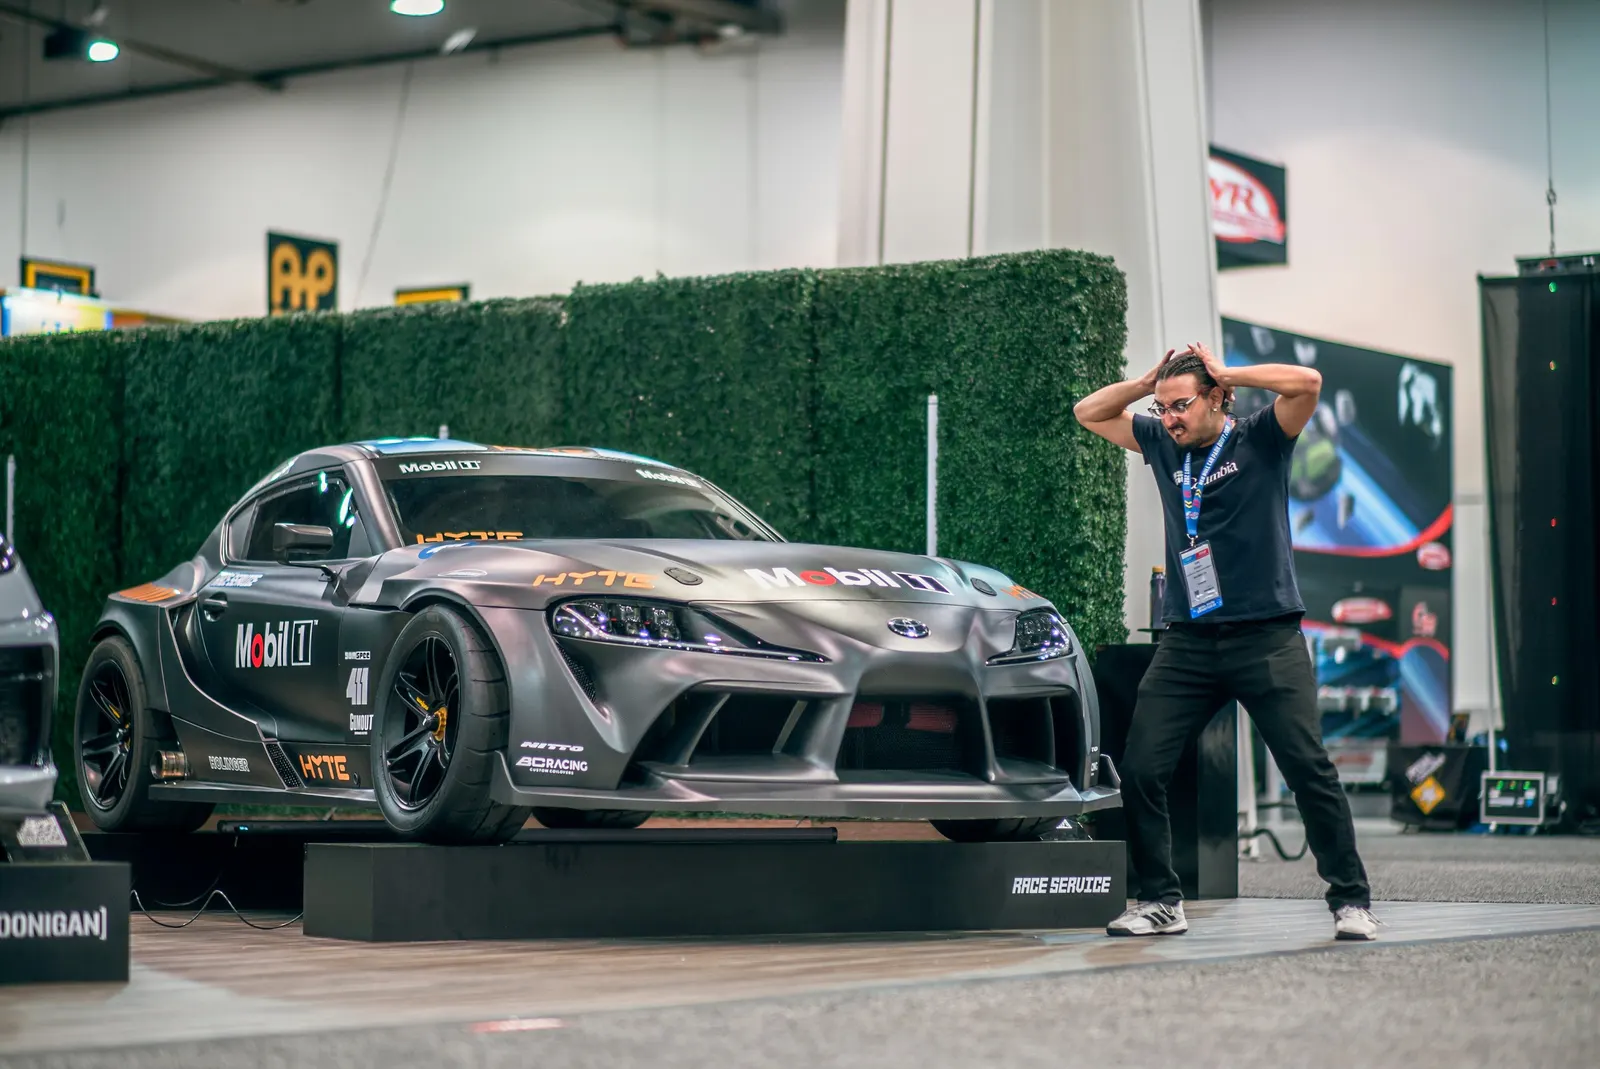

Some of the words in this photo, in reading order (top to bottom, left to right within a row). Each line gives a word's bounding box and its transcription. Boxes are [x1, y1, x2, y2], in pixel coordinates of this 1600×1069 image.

[399, 461, 457, 473] Mobil
[532, 571, 659, 589] HYTE
[744, 567, 901, 590] Mobil
[235, 620, 289, 669] Mobil
[346, 667, 369, 706] 411
[520, 741, 584, 752] NITTO
[299, 754, 350, 781] HYTE
[1012, 877, 1048, 894] RACE
[1049, 877, 1111, 894] SERVICE
